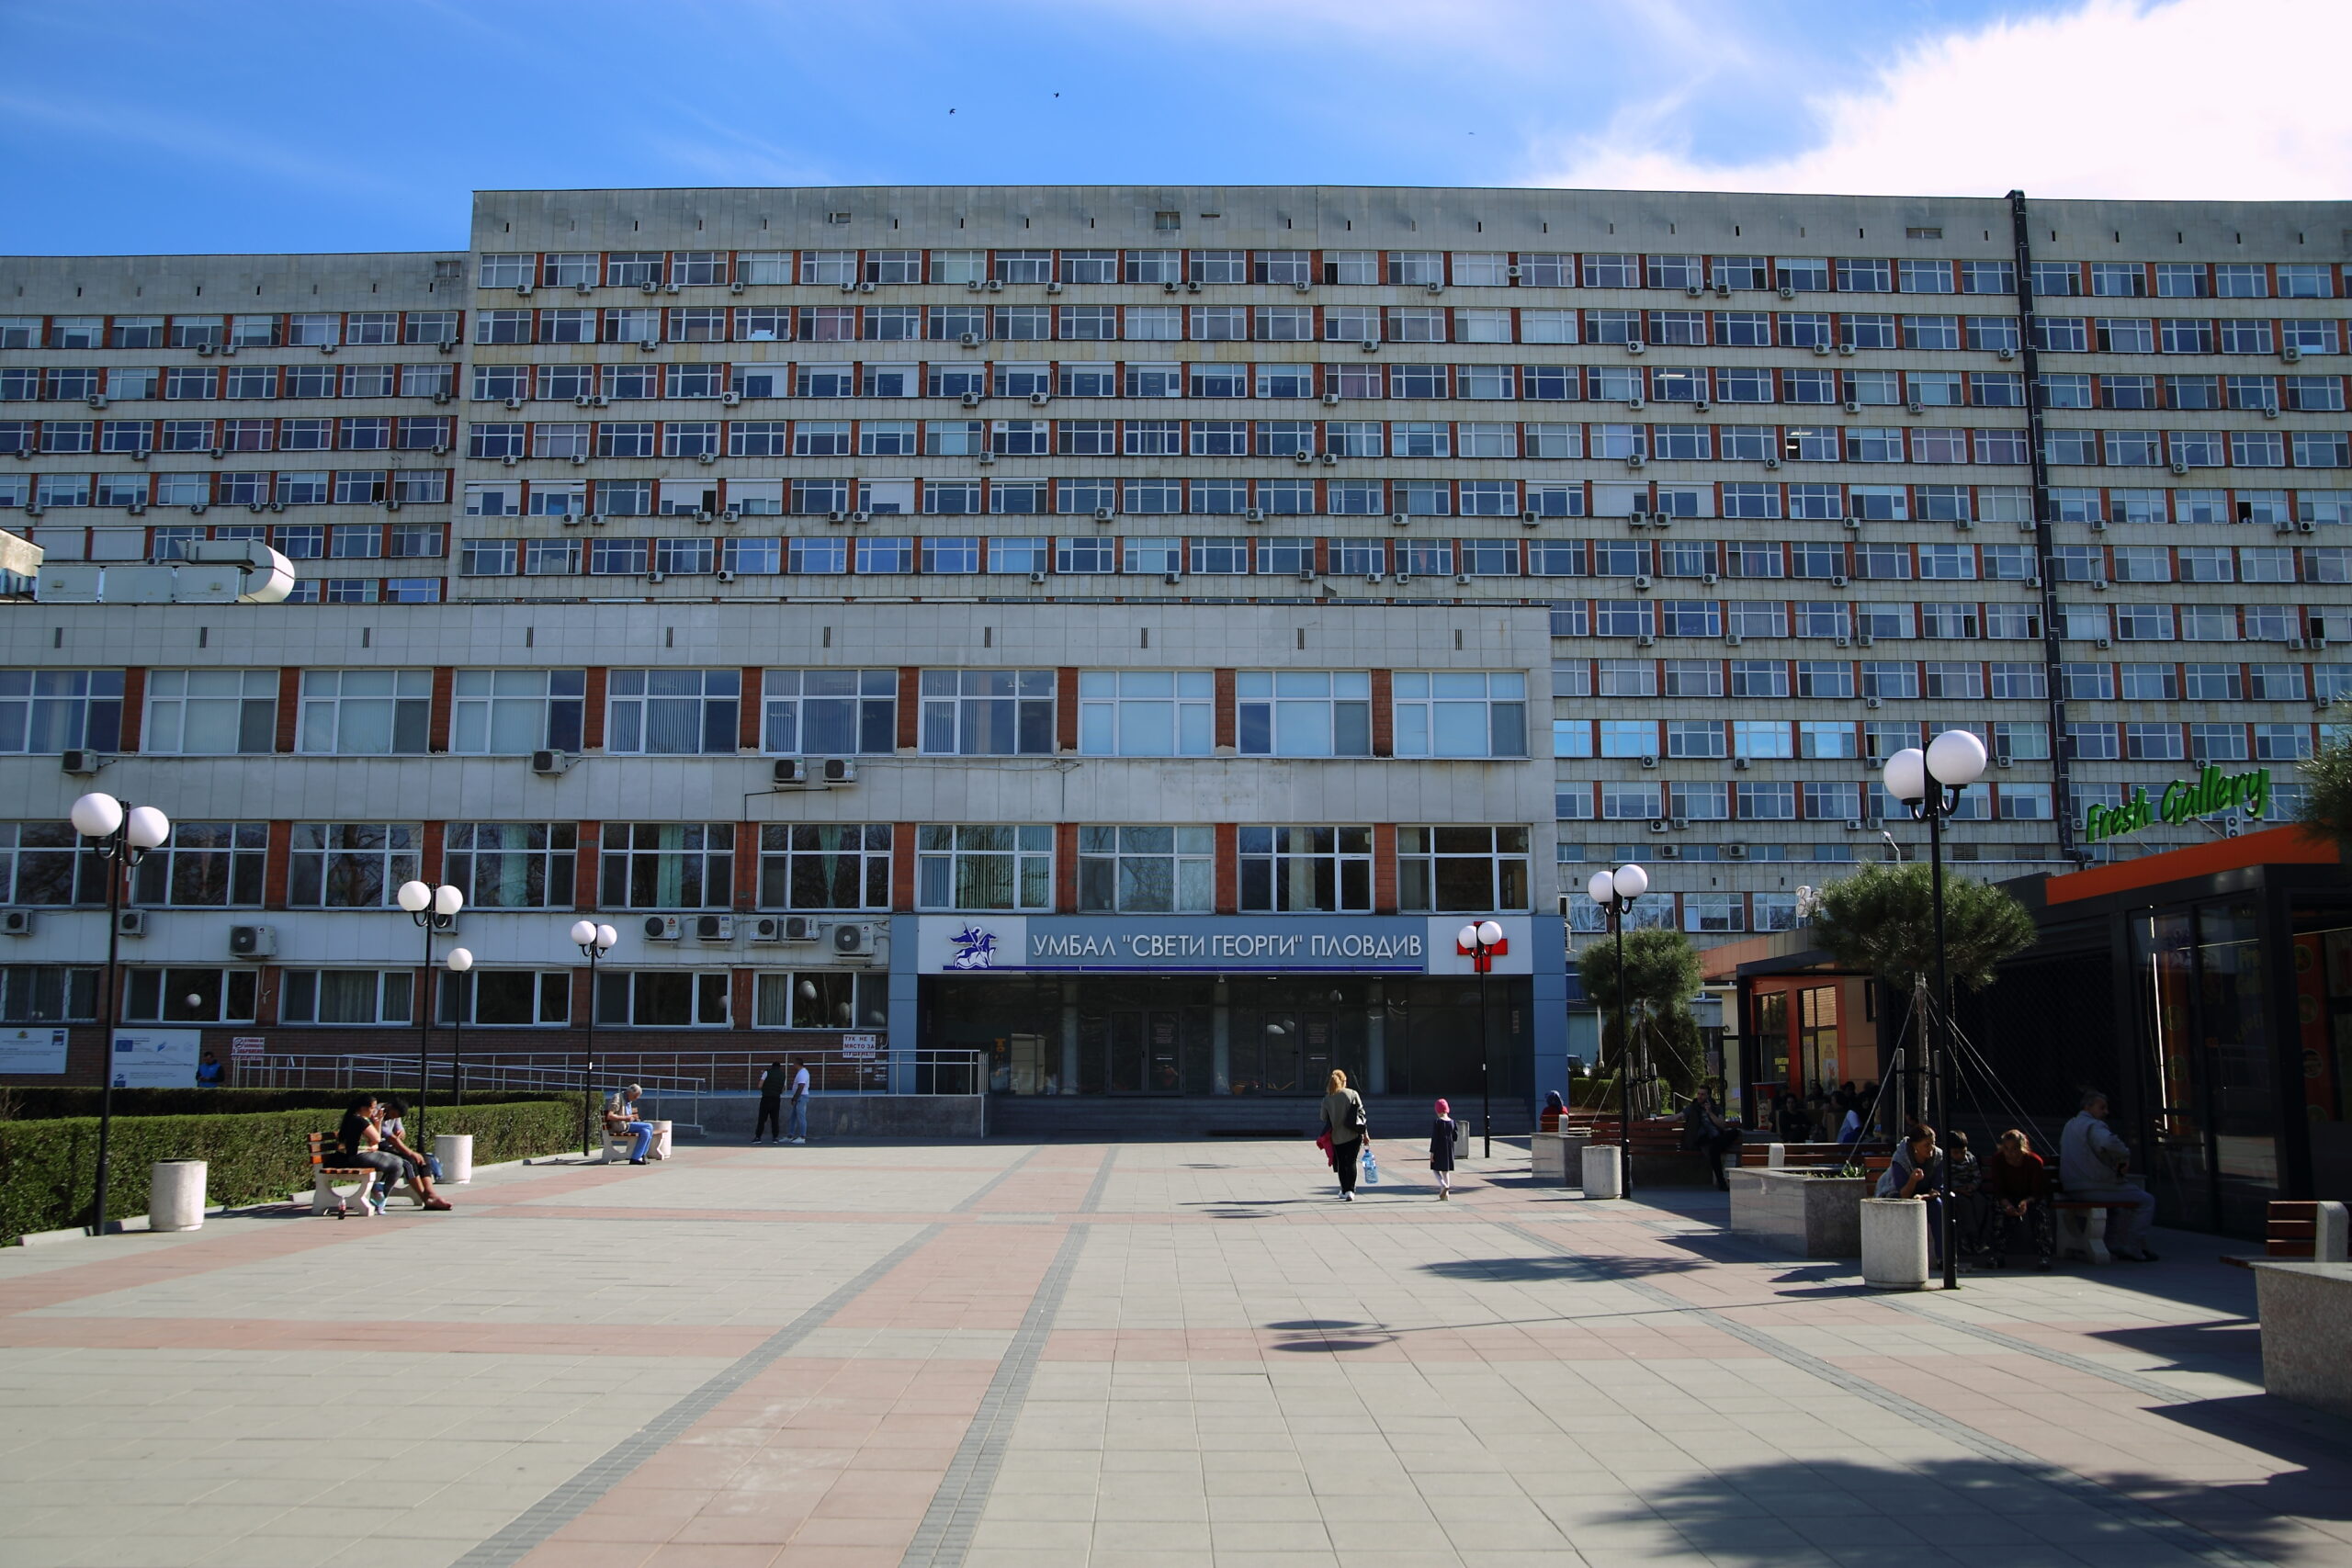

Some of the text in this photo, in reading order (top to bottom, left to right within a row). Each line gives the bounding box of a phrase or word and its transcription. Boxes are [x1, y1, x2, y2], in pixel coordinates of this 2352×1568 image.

[2086, 764, 2270, 843] Fresh Gallery
[1033, 934, 1422, 959] УМБАЛ "СВЕТИ ГЕОРГИ" ПЛОВДИВ
